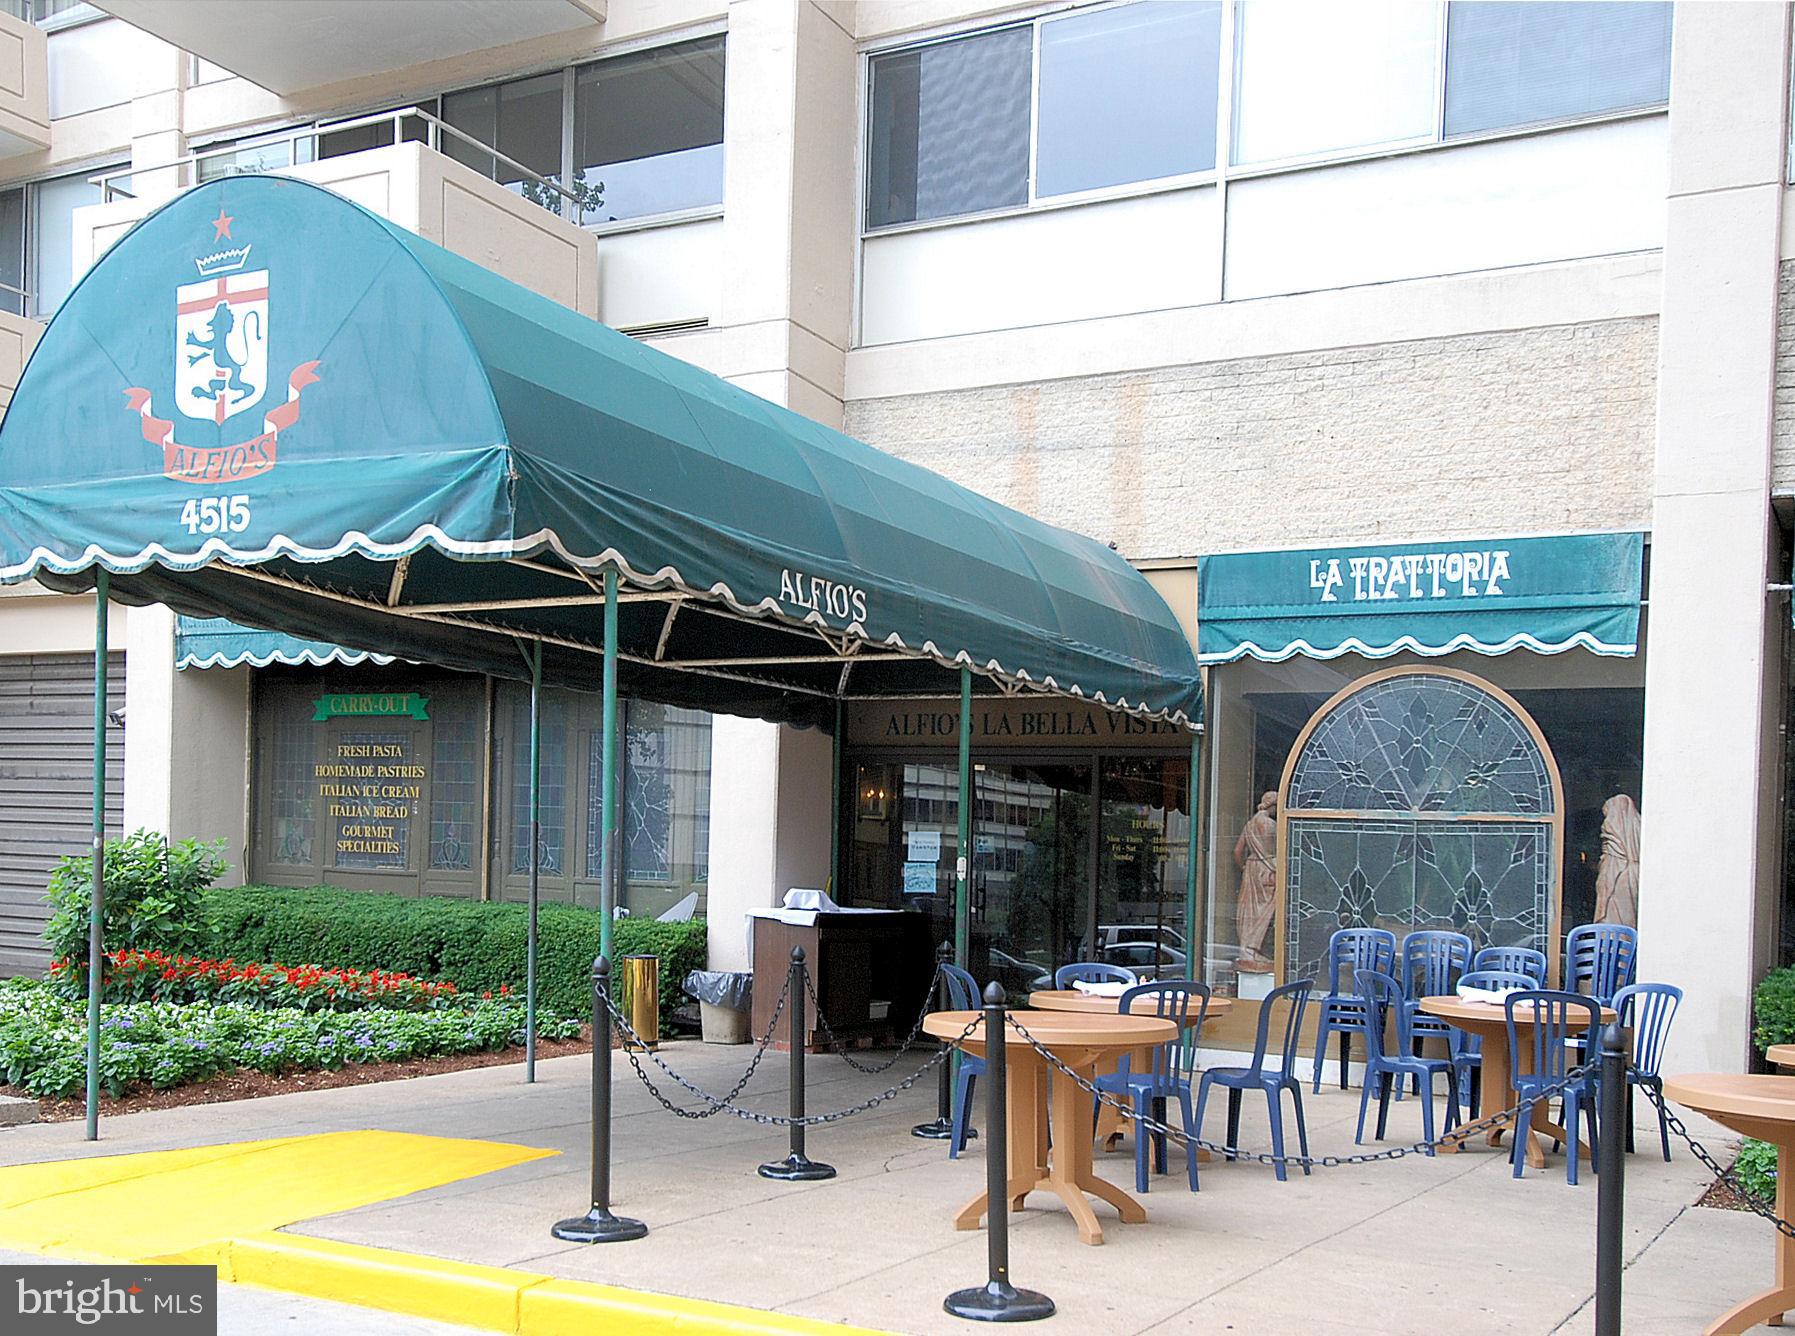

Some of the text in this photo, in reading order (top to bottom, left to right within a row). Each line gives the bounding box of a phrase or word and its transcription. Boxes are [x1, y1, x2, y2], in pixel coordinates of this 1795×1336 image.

[171, 438, 270, 479] ALFIO'S
[180, 494, 251, 535] 4515
[1309, 550, 1511, 602] LA TRATTORIA
[778, 569, 867, 623] ALFIO'S
[330, 695, 410, 713] CARRY-OUT
[983, 713, 1018, 735] LA
[1021, 711, 1098, 735] BELLA
[337, 745, 403, 757] FRESH PASTA
[315, 765, 426, 778] HOMEMADE PASTRIES
[319, 784, 420, 798] ITALIAN ICE CREAM
[329, 804, 408, 818] ITALIAN BREAD
[342, 825, 394, 838] GOURMET
[336, 840, 400, 854] SPECIALTIES
